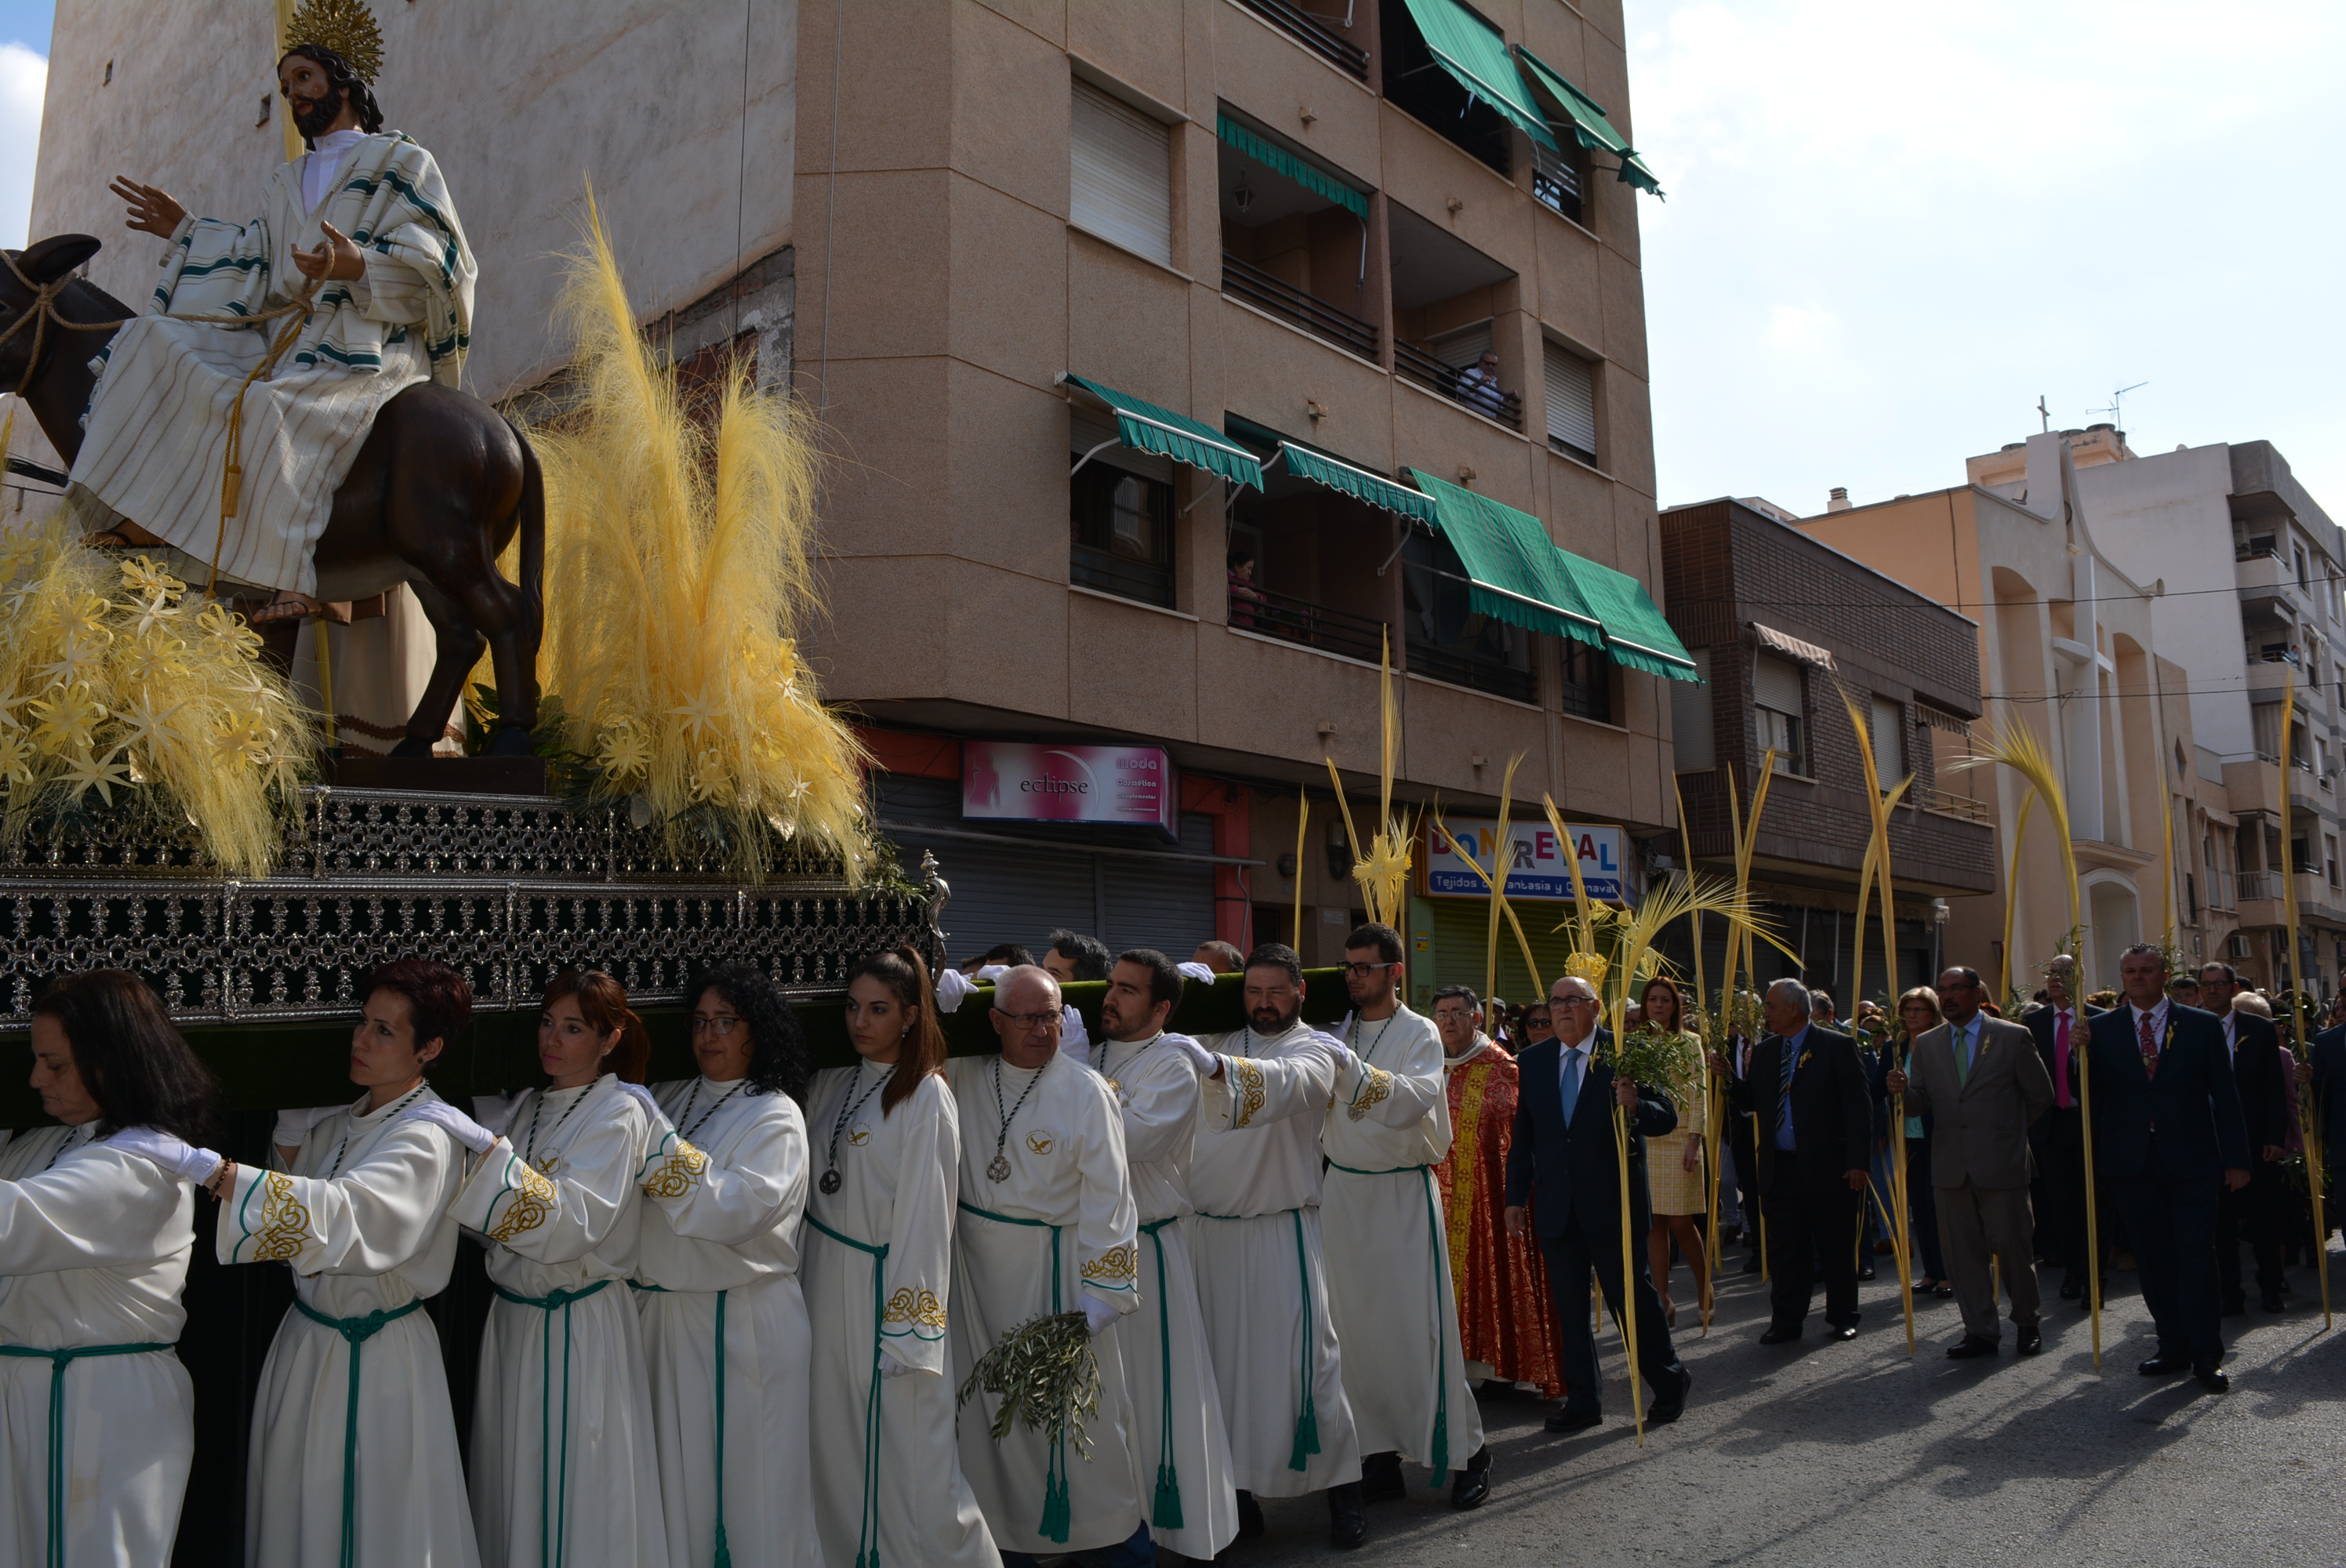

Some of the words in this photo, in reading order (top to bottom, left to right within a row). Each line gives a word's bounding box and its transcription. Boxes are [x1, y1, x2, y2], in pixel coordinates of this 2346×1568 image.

[1115, 756, 1157, 770] Moda
[1020, 772, 1089, 804] eclipse
[1116, 779, 1157, 787] Cosmética
[1436, 876, 1477, 890] Tejidos
[1505, 880, 1551, 891] antasia
[1555, 884, 1563, 895] y
[1566, 881, 1616, 894] Cnaval
